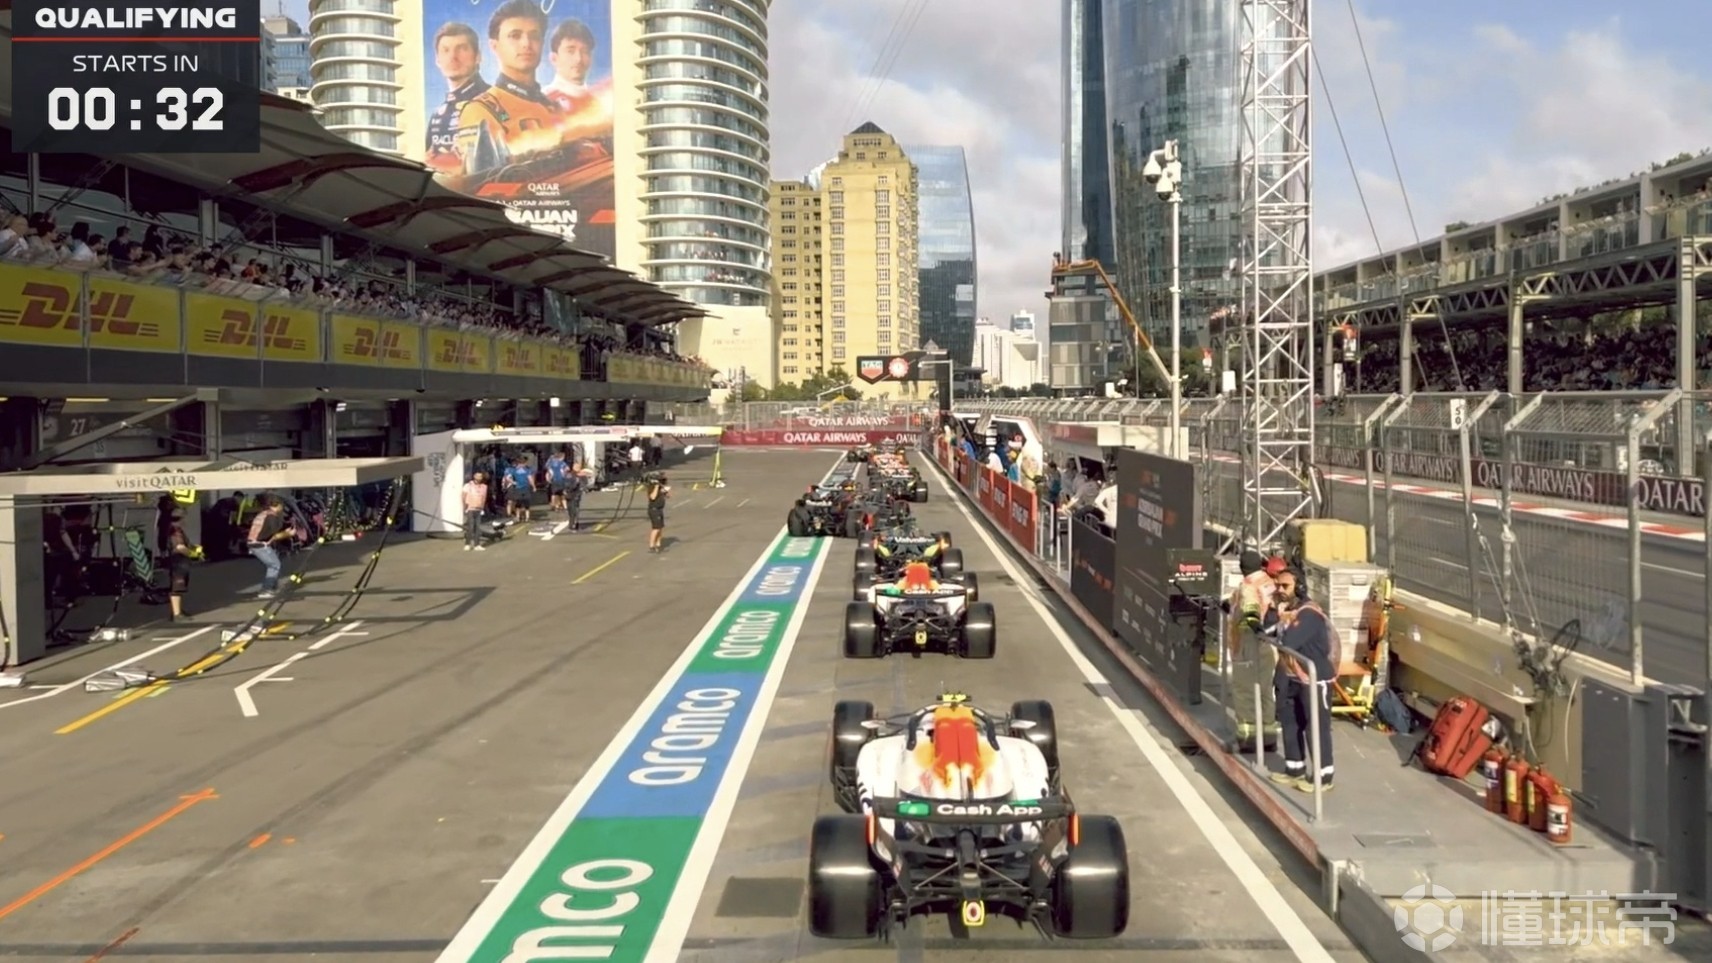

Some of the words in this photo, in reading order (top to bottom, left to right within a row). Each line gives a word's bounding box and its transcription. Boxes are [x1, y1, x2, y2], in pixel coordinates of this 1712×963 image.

[527, 183, 560, 191] QATAR
[19, 281, 141, 336] DHL
[219, 310, 294, 349] DHL
[354, 327, 403, 360] DHL
[442, 339, 479, 366] DHL
[69, 418, 87, 436] 27
[809, 417, 843, 427] QATAR
[845, 417, 889, 426] AIRWAYS
[784, 433, 821, 443] QATAR
[823, 433, 867, 443] AIRWAYS
[1375, 452, 1405, 474] QTAR
[1409, 454, 1454, 480] AIRWAYS
[1477, 461, 1523, 487] QAR
[1527, 466, 1595, 498] AIRWAYS
[116, 476, 197, 488] visitQATAR
[1635, 477, 1705, 514] QATAR
[712, 610, 781, 659] aramco
[628, 688, 742, 787] aramco
[936, 803, 992, 815] Cash
[996, 803, 1043, 817] App
